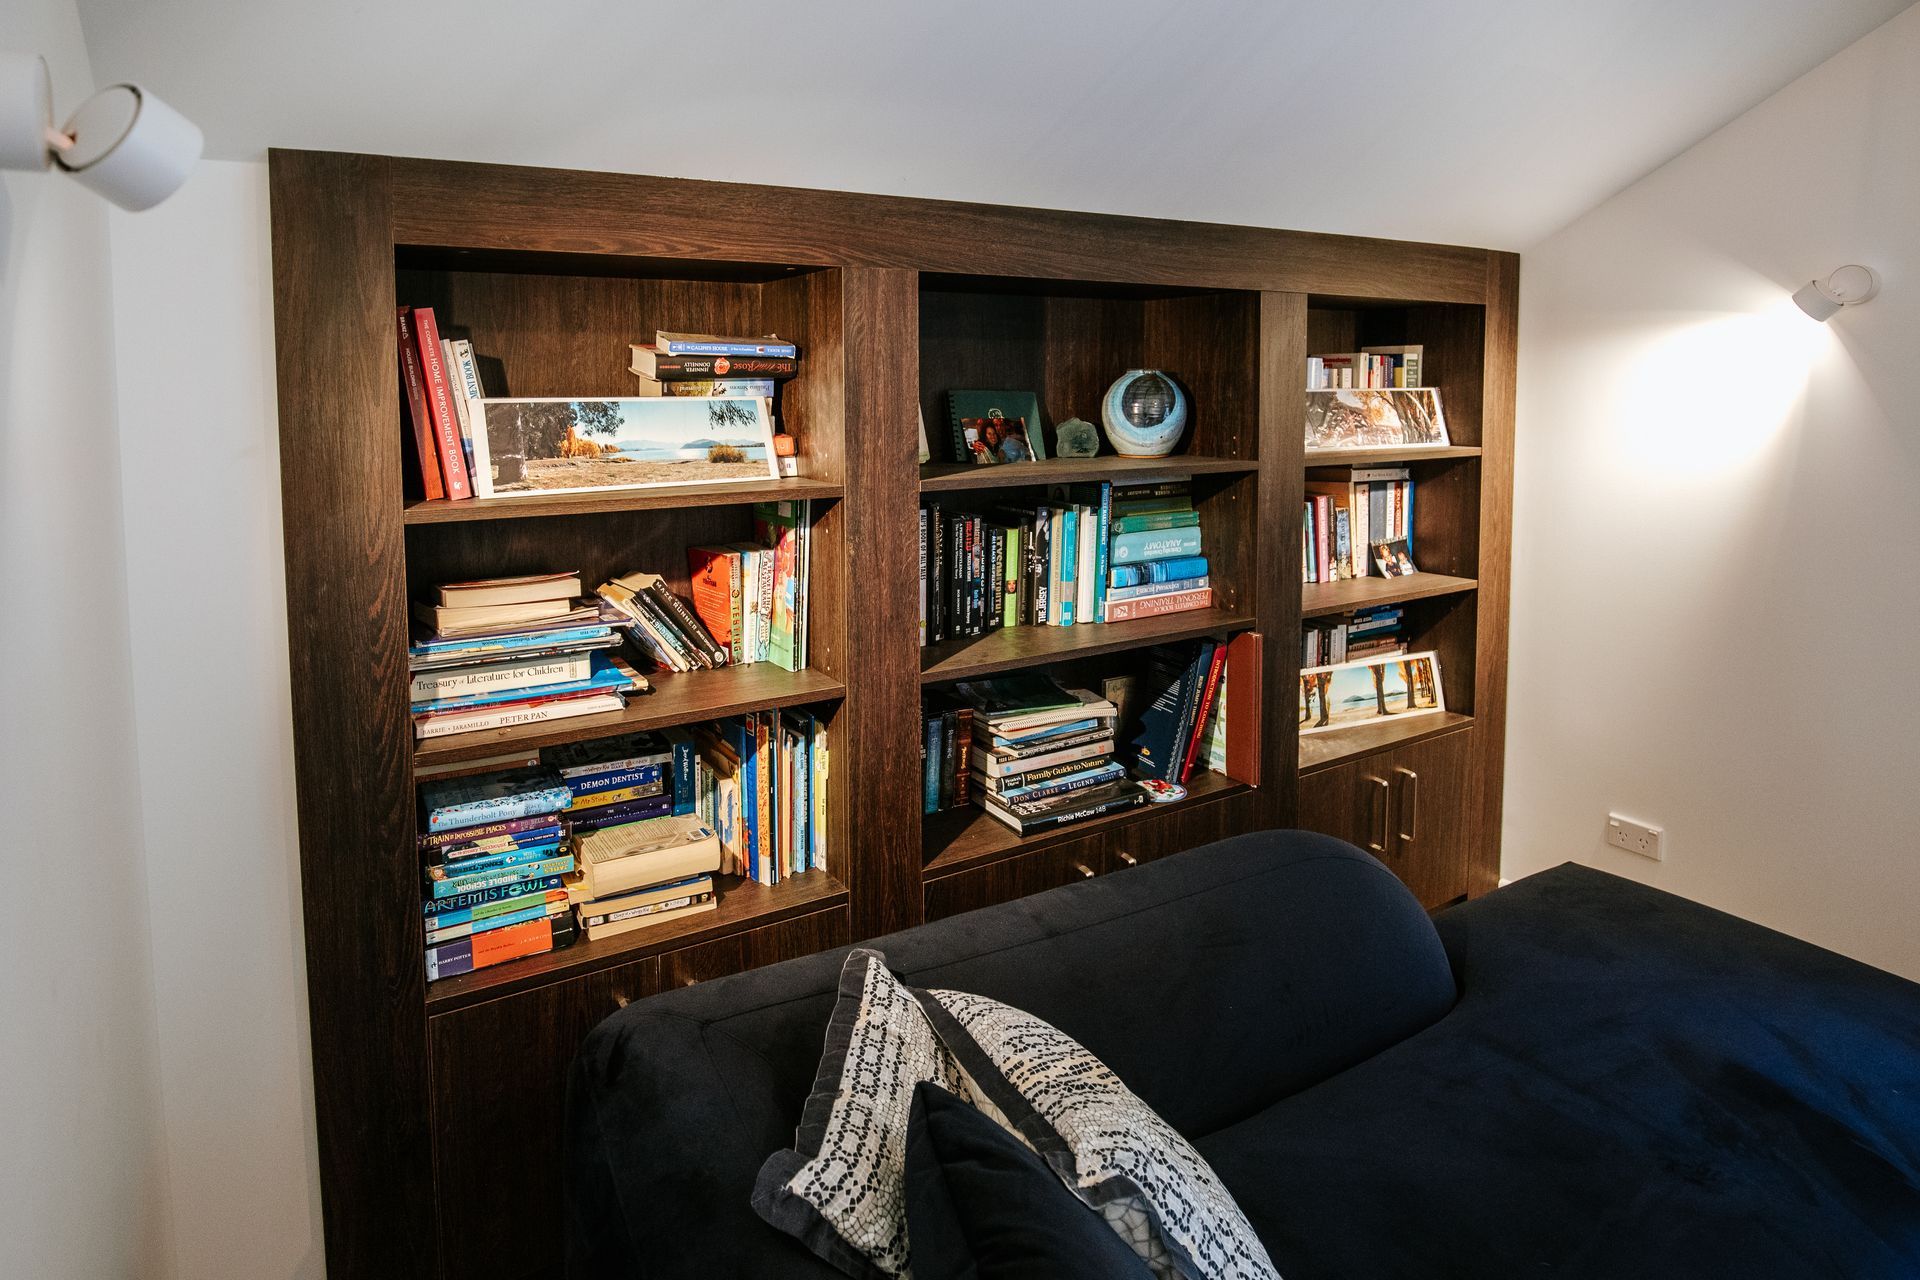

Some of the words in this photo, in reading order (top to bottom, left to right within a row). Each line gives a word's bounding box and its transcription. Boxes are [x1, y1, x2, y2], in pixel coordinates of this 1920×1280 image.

[462, 360, 474, 380] BOOK
[734, 360, 754, 371] Rose
[777, 362, 792, 372] The
[425, 331, 434, 357] COMPLETE
[430, 358, 442, 384] HOME
[437, 386, 454, 446] IMPROVEMENT
[448, 449, 460, 474] BOOK
[1144, 538, 1182, 550] ANATOMY
[655, 580, 674, 604] MAZE
[673, 601, 698, 631] RUNNER
[1038, 586, 1047, 608] JERSEY
[1140, 596, 1174, 609] TRAINING
[1174, 600, 1200, 610] COMPLETE
[1176, 592, 1208, 602] PERSONAL
[1038, 608, 1046, 624] THE
[732, 604, 741, 652] TESTING
[416, 678, 458, 692] Treasury
[466, 670, 510, 684] Literature
[512, 669, 524, 678] for
[527, 665, 564, 676] Children
[1207, 659, 1221, 701] INTRODUCTION
[1204, 701, 1210, 710] TO
[452, 720, 490, 731] JARAMILLO
[500, 714, 529, 724] PETER
[530, 711, 548, 720] PAN
[1196, 710, 1208, 739] COACHING
[1026, 770, 1052, 782] Family
[1052, 767, 1073, 776] Guide
[1080, 759, 1105, 769] Nature
[580, 778, 610, 790] DEMON
[612, 772, 644, 784] DENTIST
[592, 795, 608, 803] Stink
[1012, 794, 1030, 804] DON
[1032, 787, 1060, 798] CLARKE
[1068, 778, 1094, 790] LEGEND
[448, 812, 496, 826] Thunderbolt
[498, 810, 516, 818] Pony
[1057, 814, 1074, 823] Richie
[1074, 810, 1095, 820] McCaw
[428, 834, 450, 846] TRAIN
[454, 830, 484, 840] IMPOSSIBLE
[486, 825, 506, 834] PLACES
[457, 881, 486, 892] SCHOOL
[488, 875, 518, 886] MIDDLE
[424, 888, 498, 914] ARTEMIS
[438, 956, 453, 966] HARRY
[454, 953, 472, 962] POTTER
